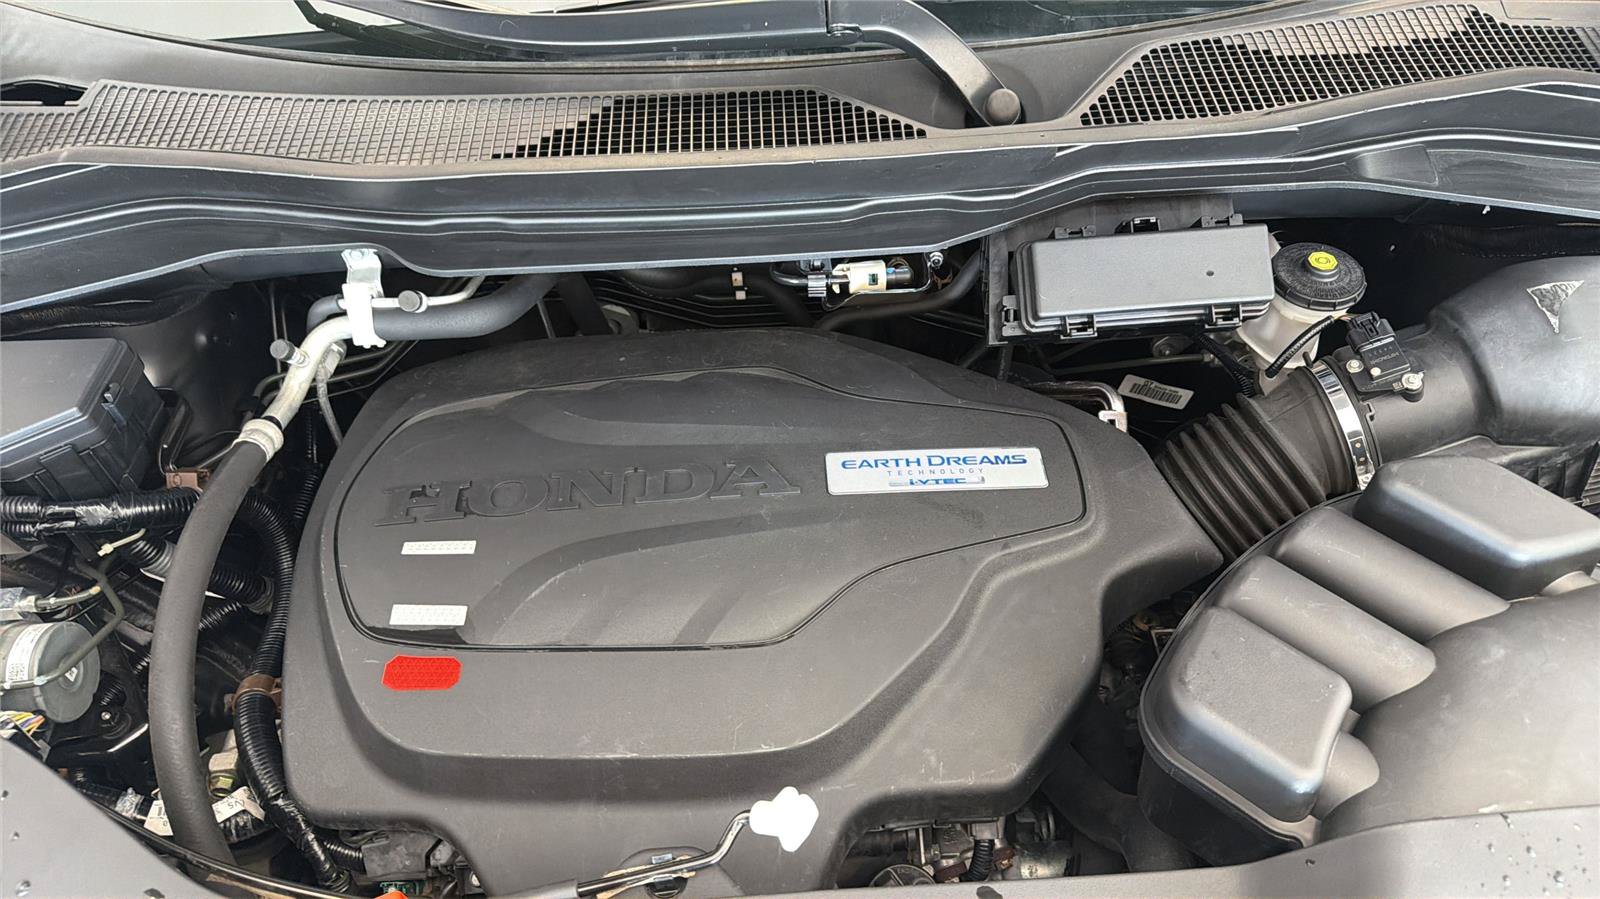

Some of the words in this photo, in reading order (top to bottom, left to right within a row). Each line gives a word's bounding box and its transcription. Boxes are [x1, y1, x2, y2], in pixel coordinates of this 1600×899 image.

[842, 460, 921, 470] EARTH
[887, 468, 984, 476] TECHNOLOGY
[373, 459, 801, 526] HONDA
